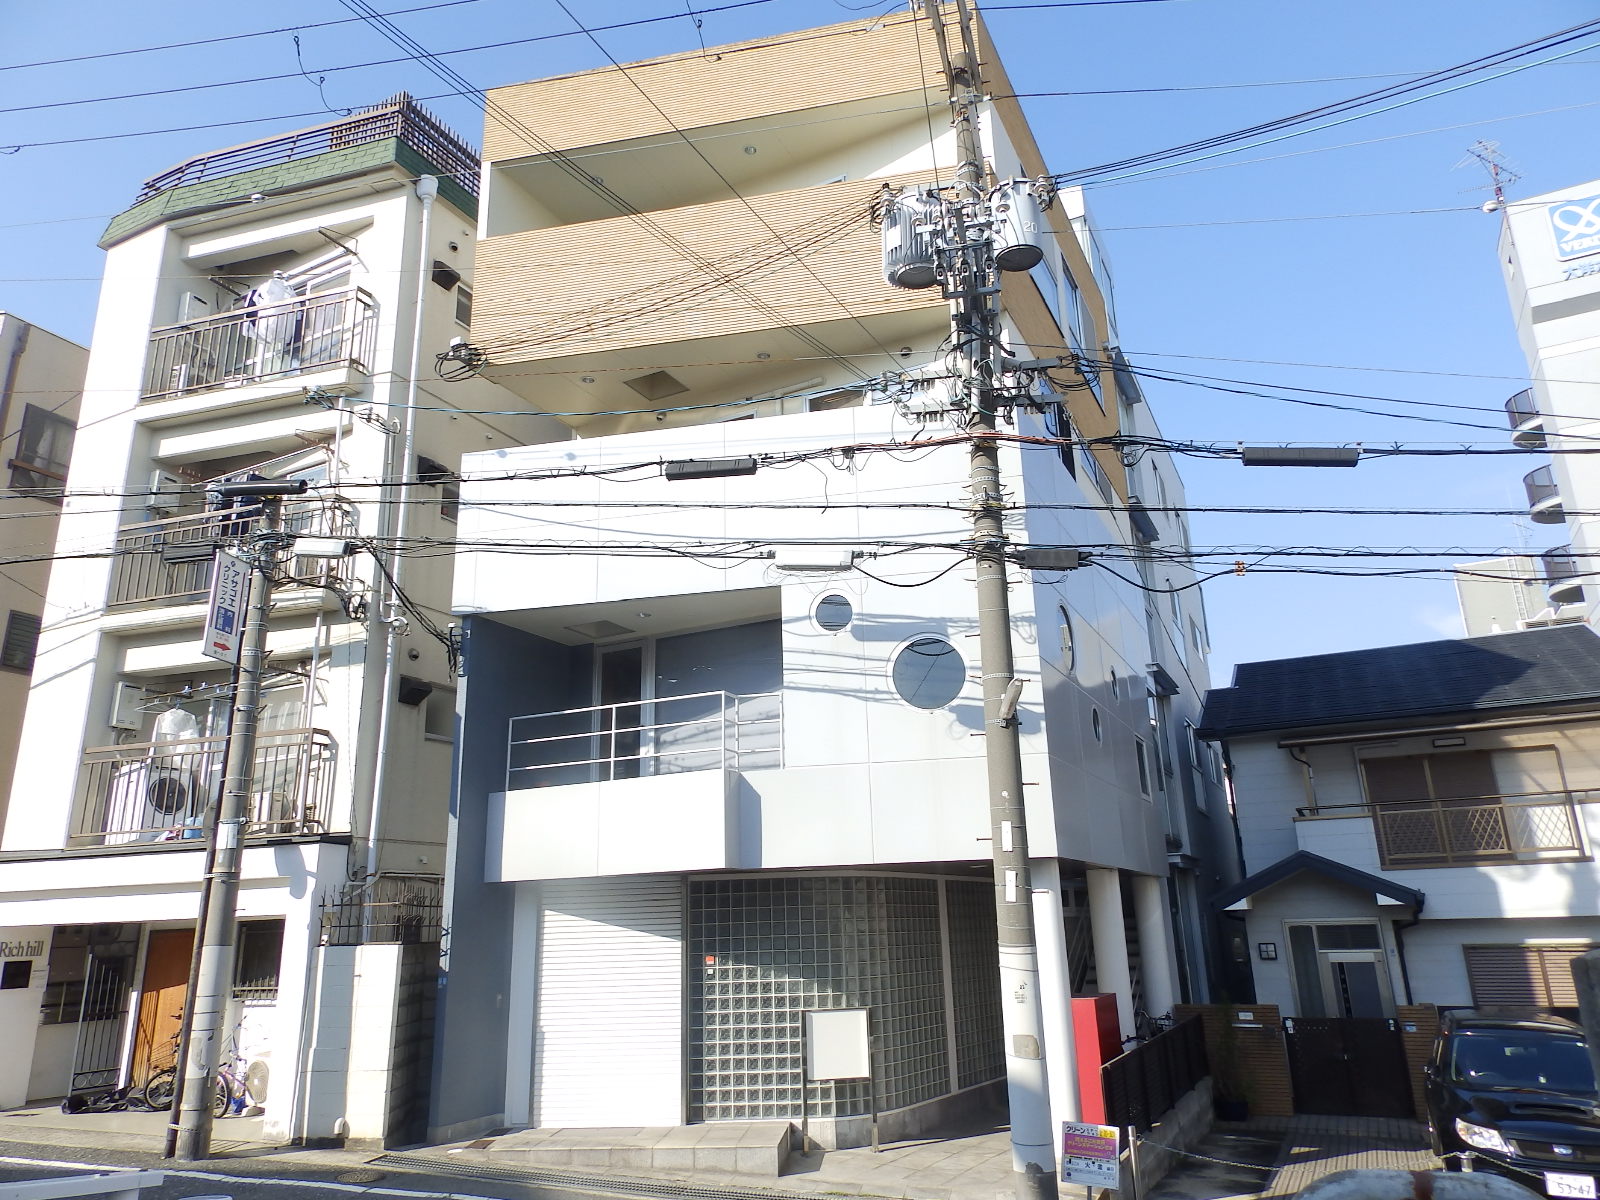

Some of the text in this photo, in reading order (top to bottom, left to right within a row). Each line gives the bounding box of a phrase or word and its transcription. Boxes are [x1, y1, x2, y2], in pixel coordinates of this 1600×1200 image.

[1024, 220, 1037, 233] 20
[219, 565, 231, 605] クリニック
[0, 940, 44, 957] Rich hill
